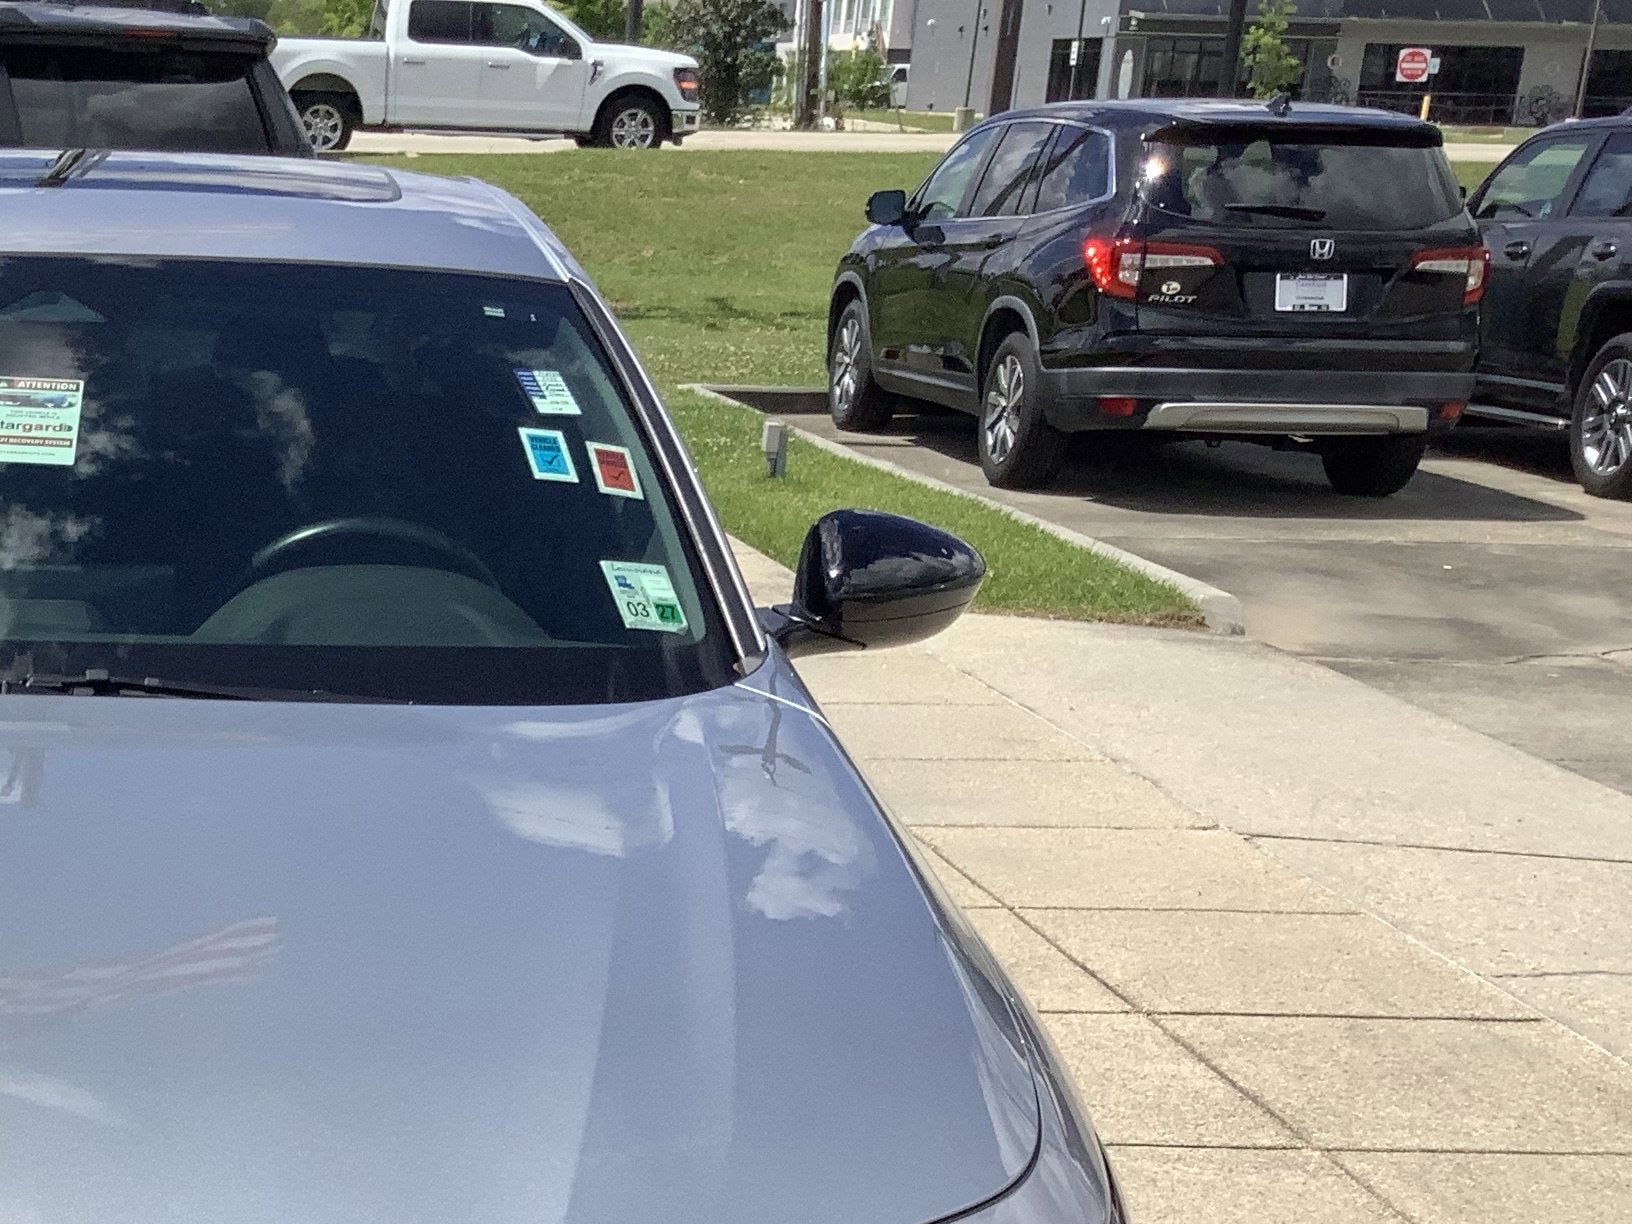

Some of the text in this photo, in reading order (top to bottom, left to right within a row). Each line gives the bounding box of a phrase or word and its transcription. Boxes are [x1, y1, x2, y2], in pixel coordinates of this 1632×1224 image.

[1148, 294, 1197, 303] PILOT
[17, 380, 77, 391] ATTENTION
[626, 601, 650, 618] 03
[655, 604, 676, 620] 27
